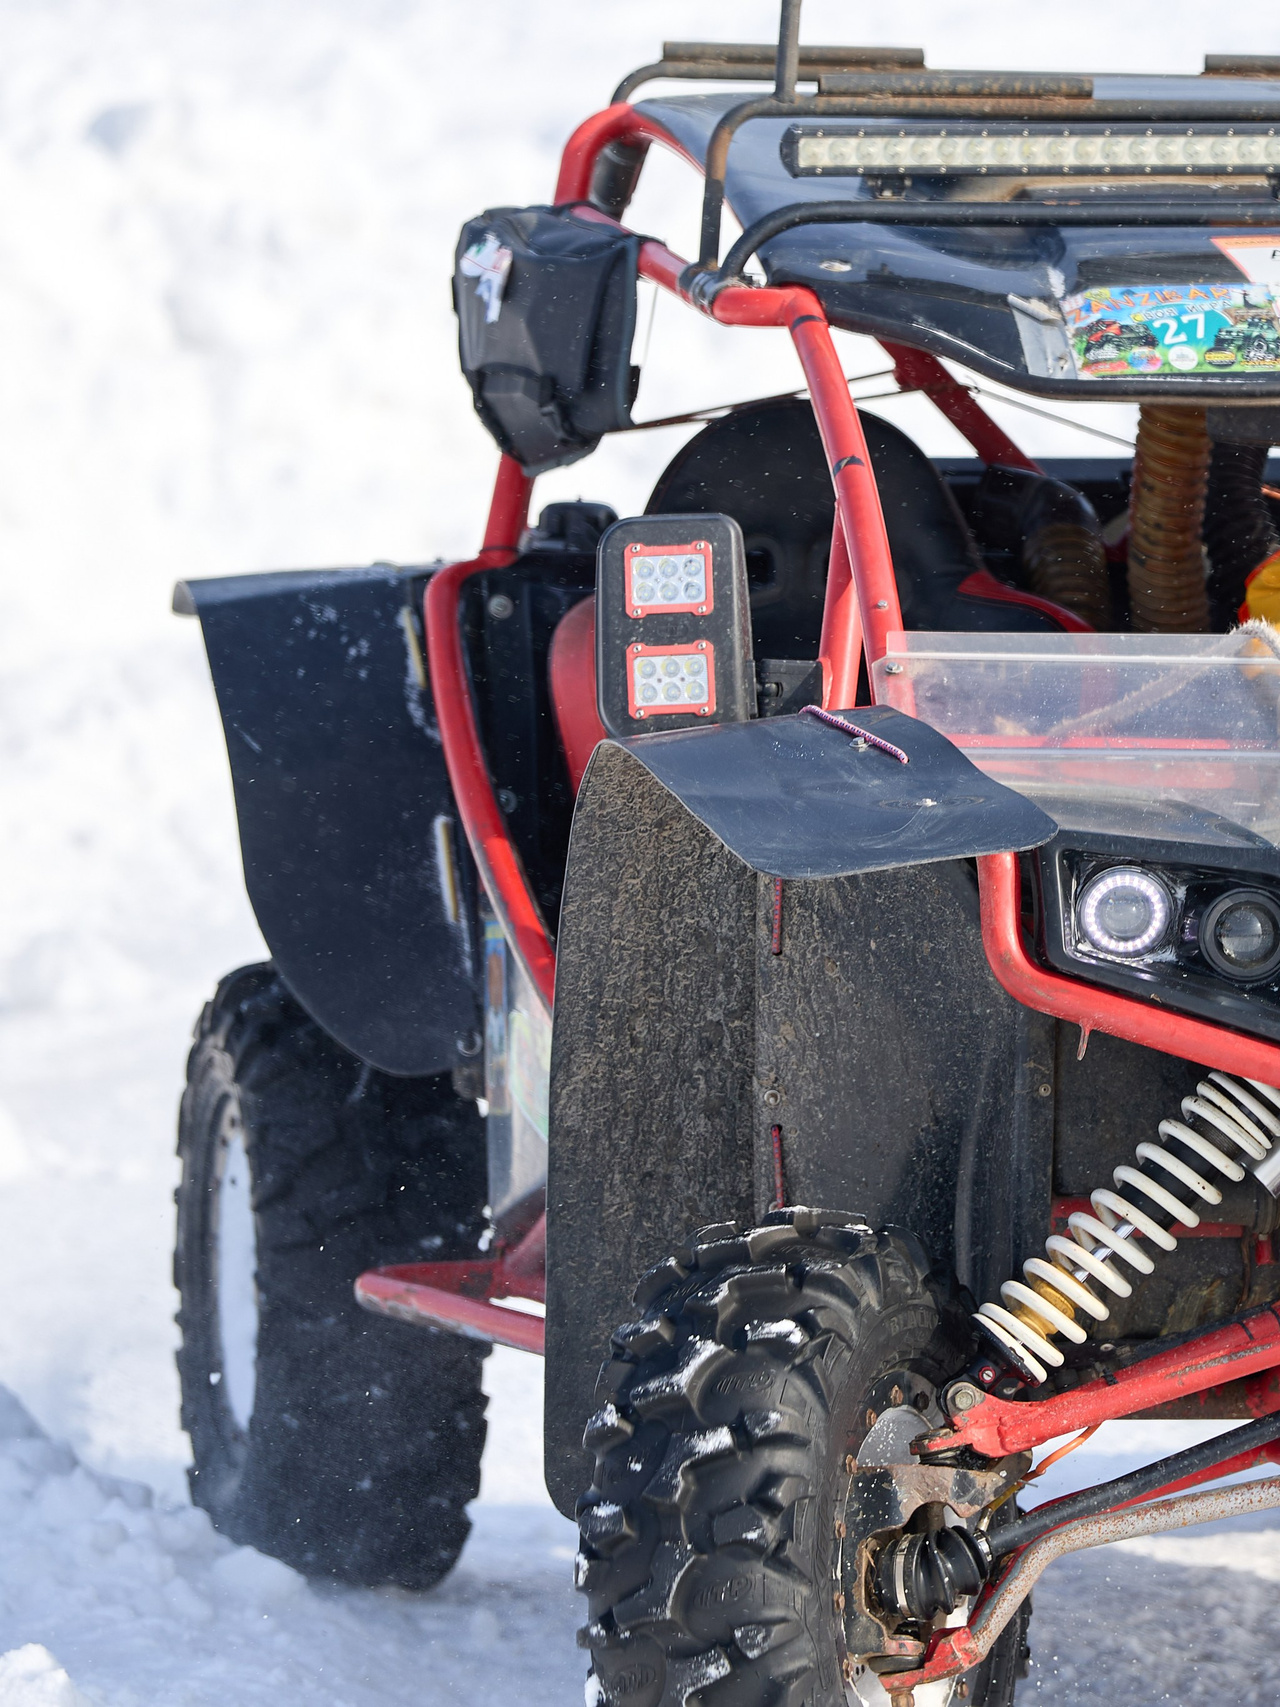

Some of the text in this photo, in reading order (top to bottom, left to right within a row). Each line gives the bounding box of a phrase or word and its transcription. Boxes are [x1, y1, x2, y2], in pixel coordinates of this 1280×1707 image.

[1066, 286, 1231, 325] ZANZIBAR
[1187, 299, 1232, 314] ИГРА
[1153, 313, 1205, 345] 27
